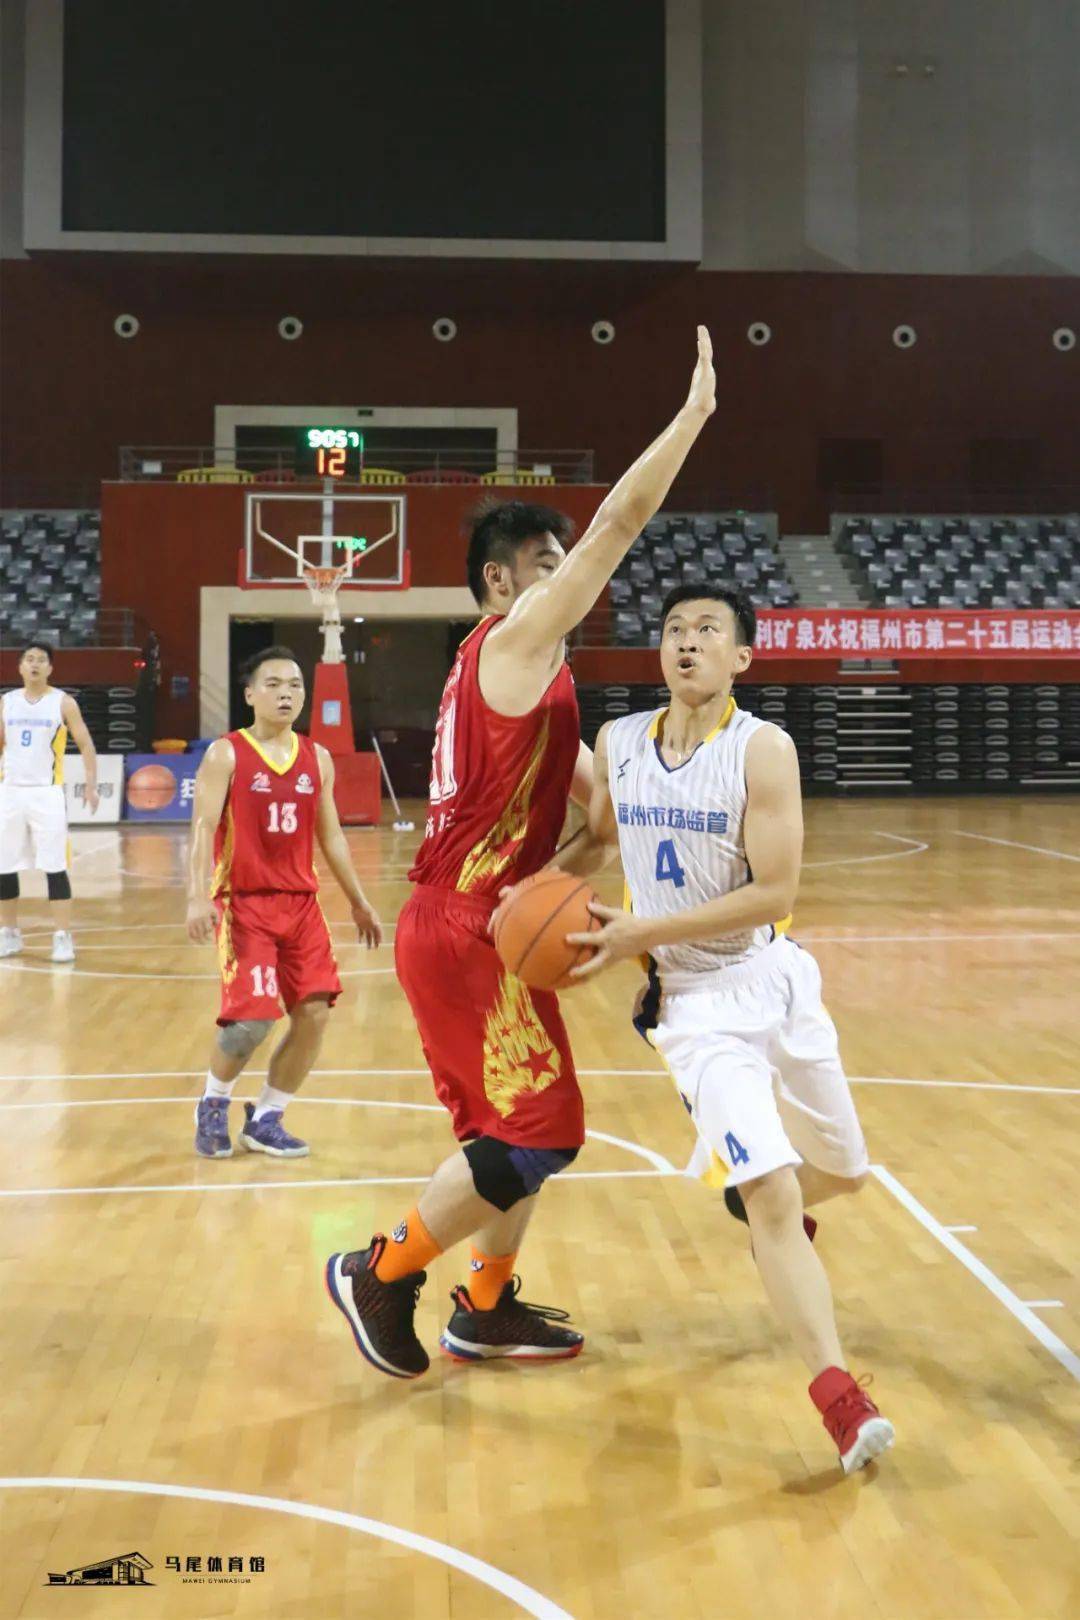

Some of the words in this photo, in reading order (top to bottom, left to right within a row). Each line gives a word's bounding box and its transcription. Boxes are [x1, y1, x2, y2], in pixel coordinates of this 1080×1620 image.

[318, 449, 346, 476] 12
[21, 730, 32, 747] 9
[267, 801, 298, 834] 13
[617, 802, 728, 834] 福州市场监管
[656, 838, 685, 889] 4
[250, 965, 279, 998] 13
[724, 1130, 750, 1166] 4
